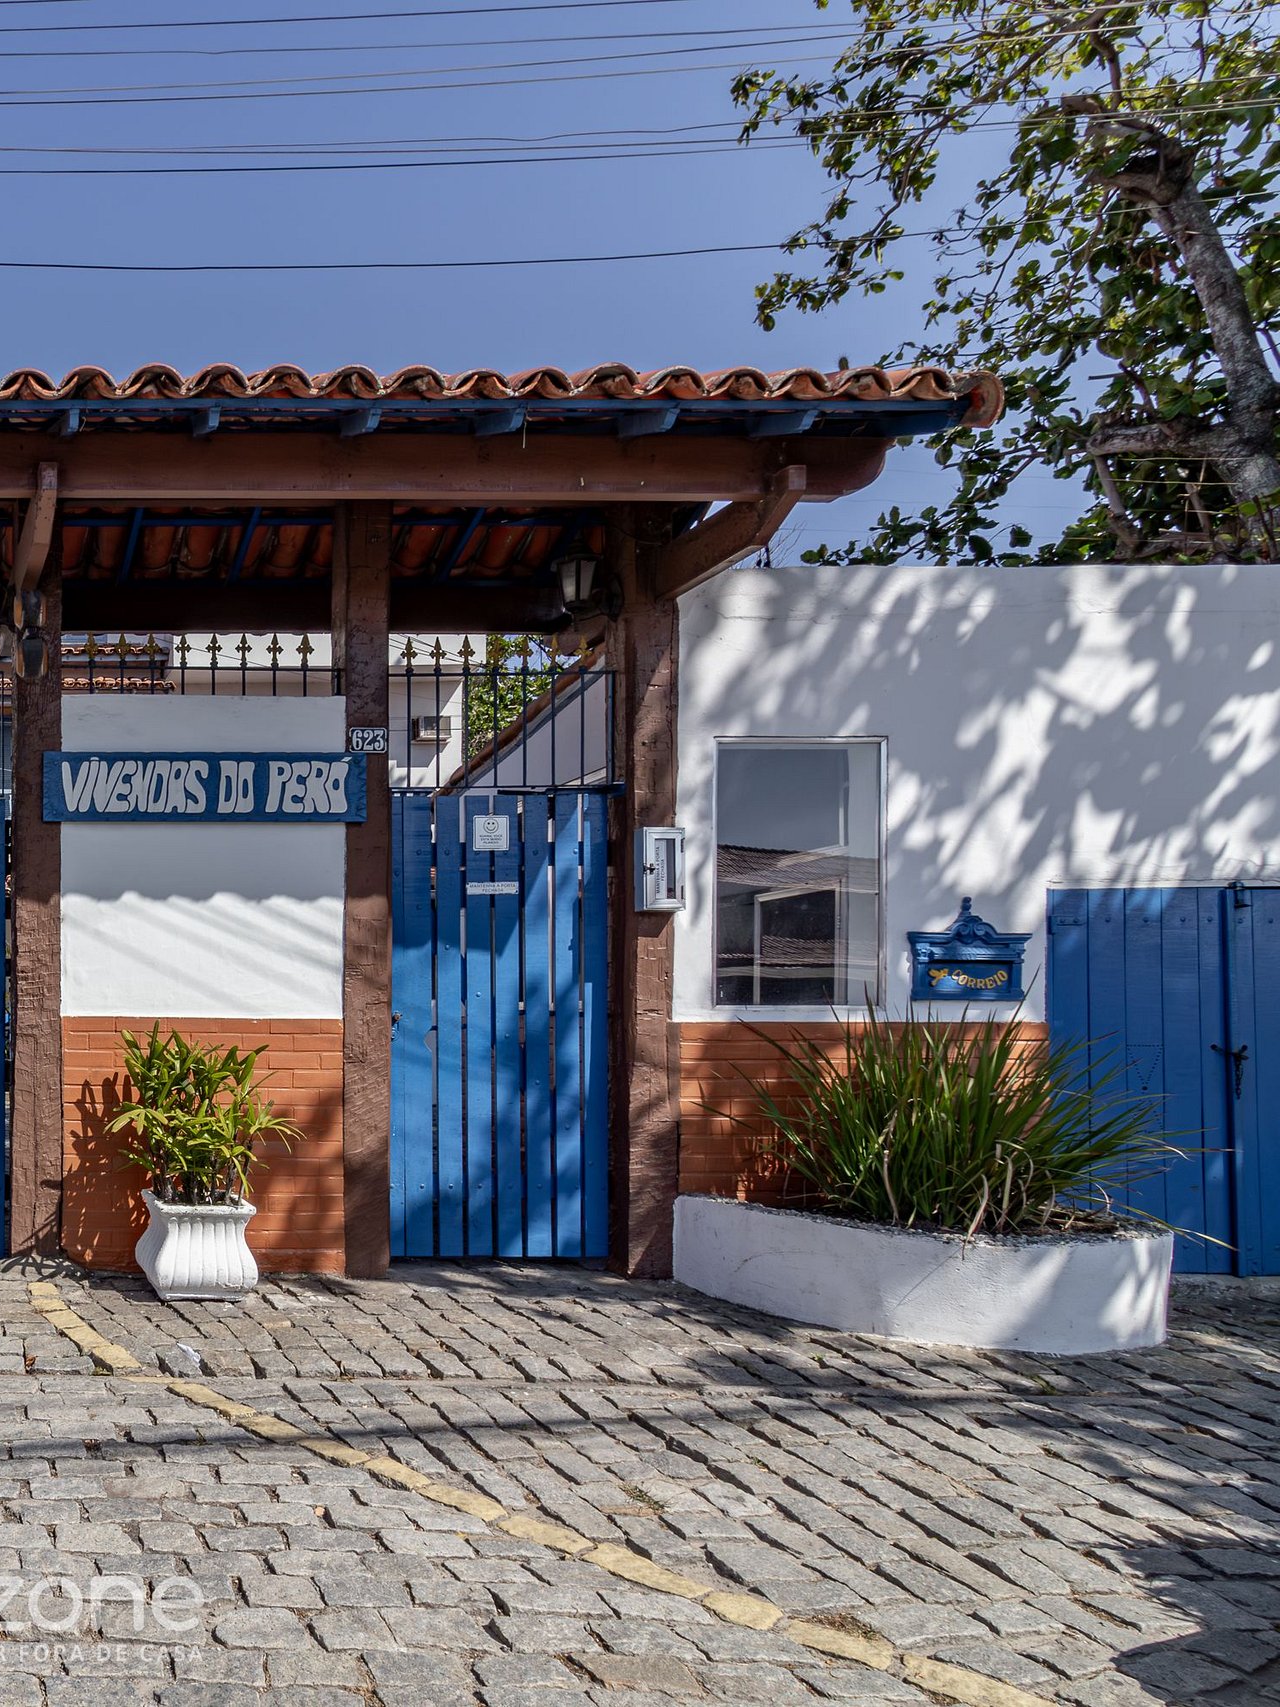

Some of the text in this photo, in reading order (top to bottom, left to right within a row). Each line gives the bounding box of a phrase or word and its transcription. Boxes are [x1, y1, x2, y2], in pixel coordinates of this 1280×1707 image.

[352, 729, 385, 751] 623
[61, 756, 352, 813] VIVENDAS DO PERÓ
[951, 969, 1009, 989] CORREIO
